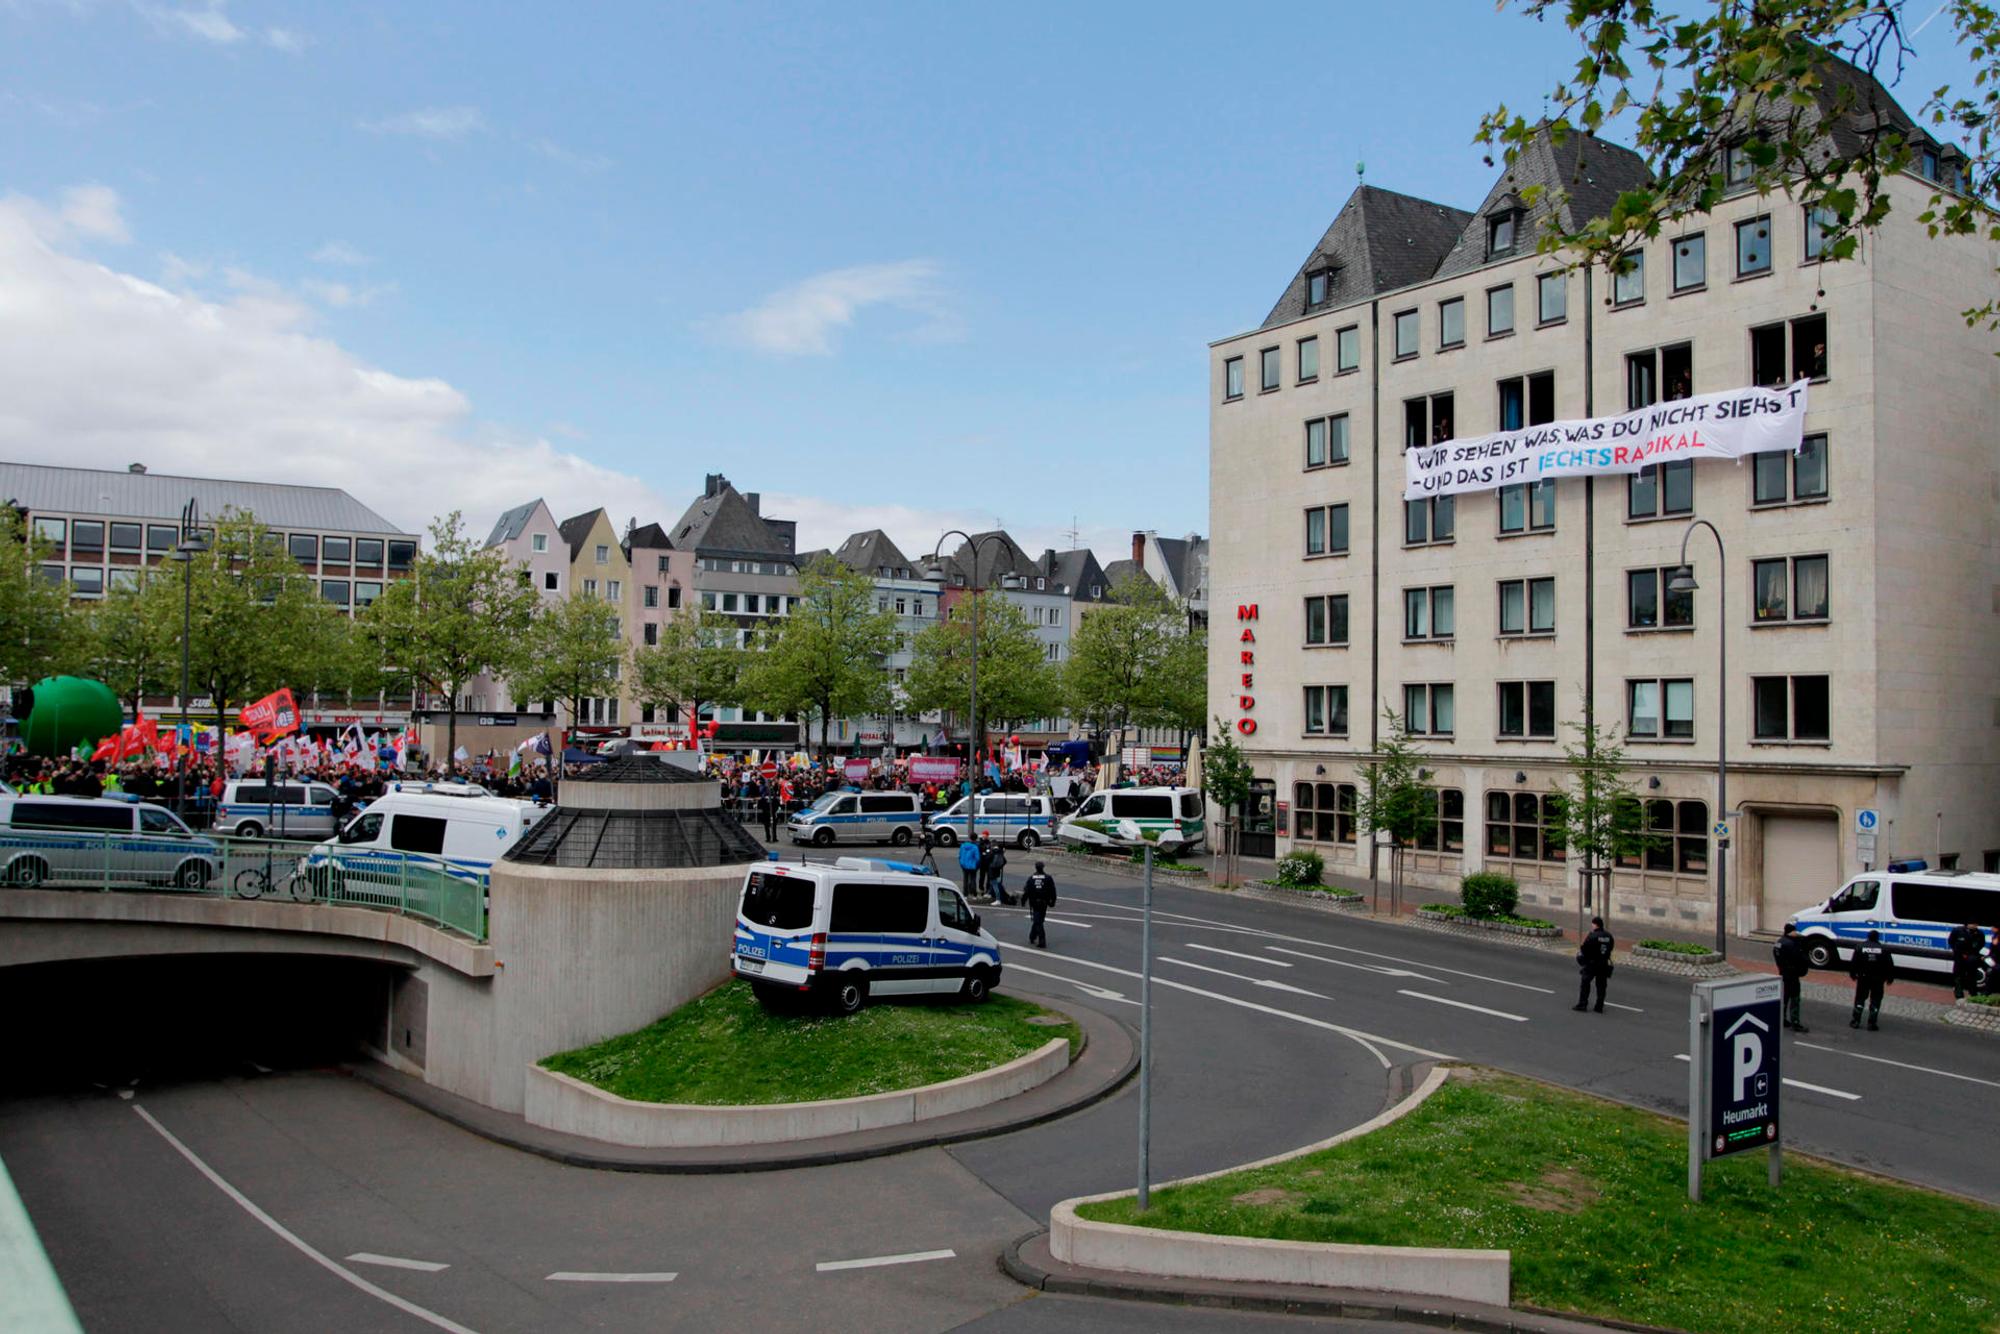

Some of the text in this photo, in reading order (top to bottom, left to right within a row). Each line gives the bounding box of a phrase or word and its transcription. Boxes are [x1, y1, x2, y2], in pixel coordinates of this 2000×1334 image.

[1417, 449, 1447, 469] WIR
[1453, 439, 1516, 461] SEHEN
[1565, 423, 1605, 443] WAS
[1612, 418, 1642, 438] DU
[1650, 404, 1708, 431] NICHT
[1457, 466, 1494, 485] DAS
[1500, 457, 1529, 480] IST
[1237, 603, 1258, 735] MAREDO
[737, 943, 766, 957] POLIZEI
[1898, 935, 1933, 947] POLIZEI
[892, 954, 920, 964] POLIZEI
[1733, 1032, 1763, 1102] P
[1723, 1102, 1768, 1125] Heumarkt
